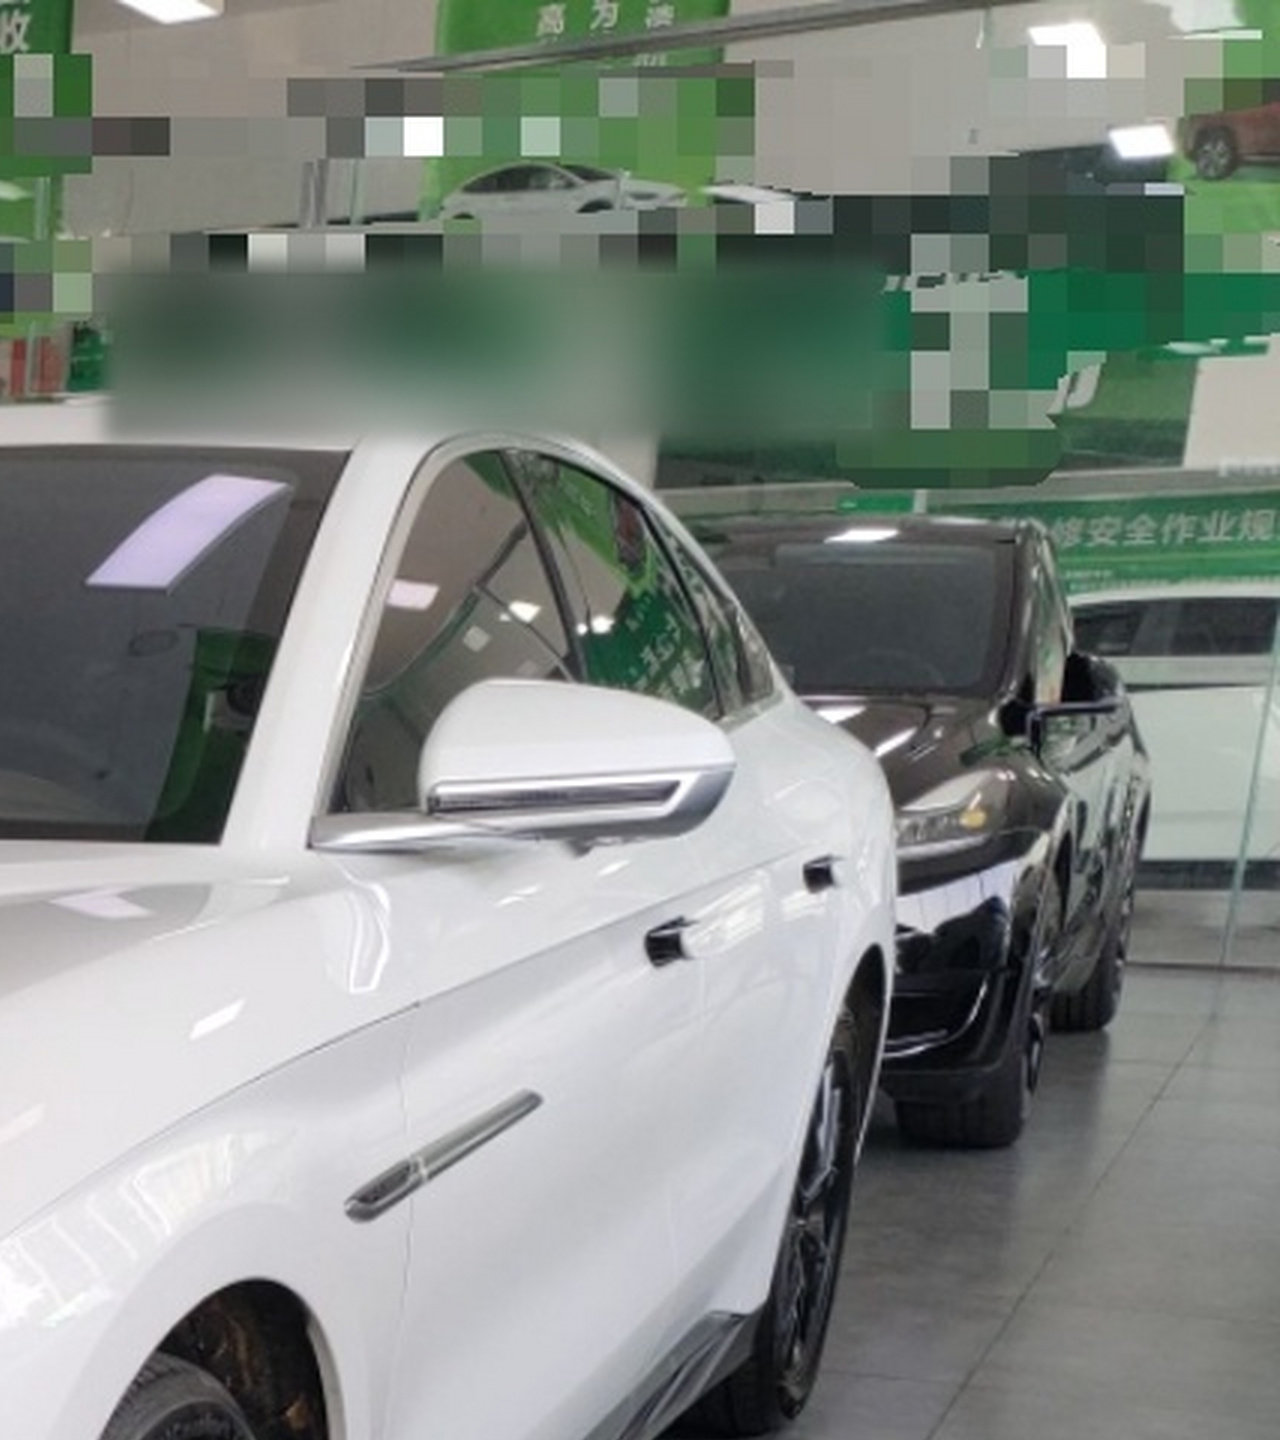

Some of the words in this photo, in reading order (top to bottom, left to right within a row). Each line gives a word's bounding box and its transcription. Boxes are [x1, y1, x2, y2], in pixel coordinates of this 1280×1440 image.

[1052, 508, 1280, 549] 修安全作业规
